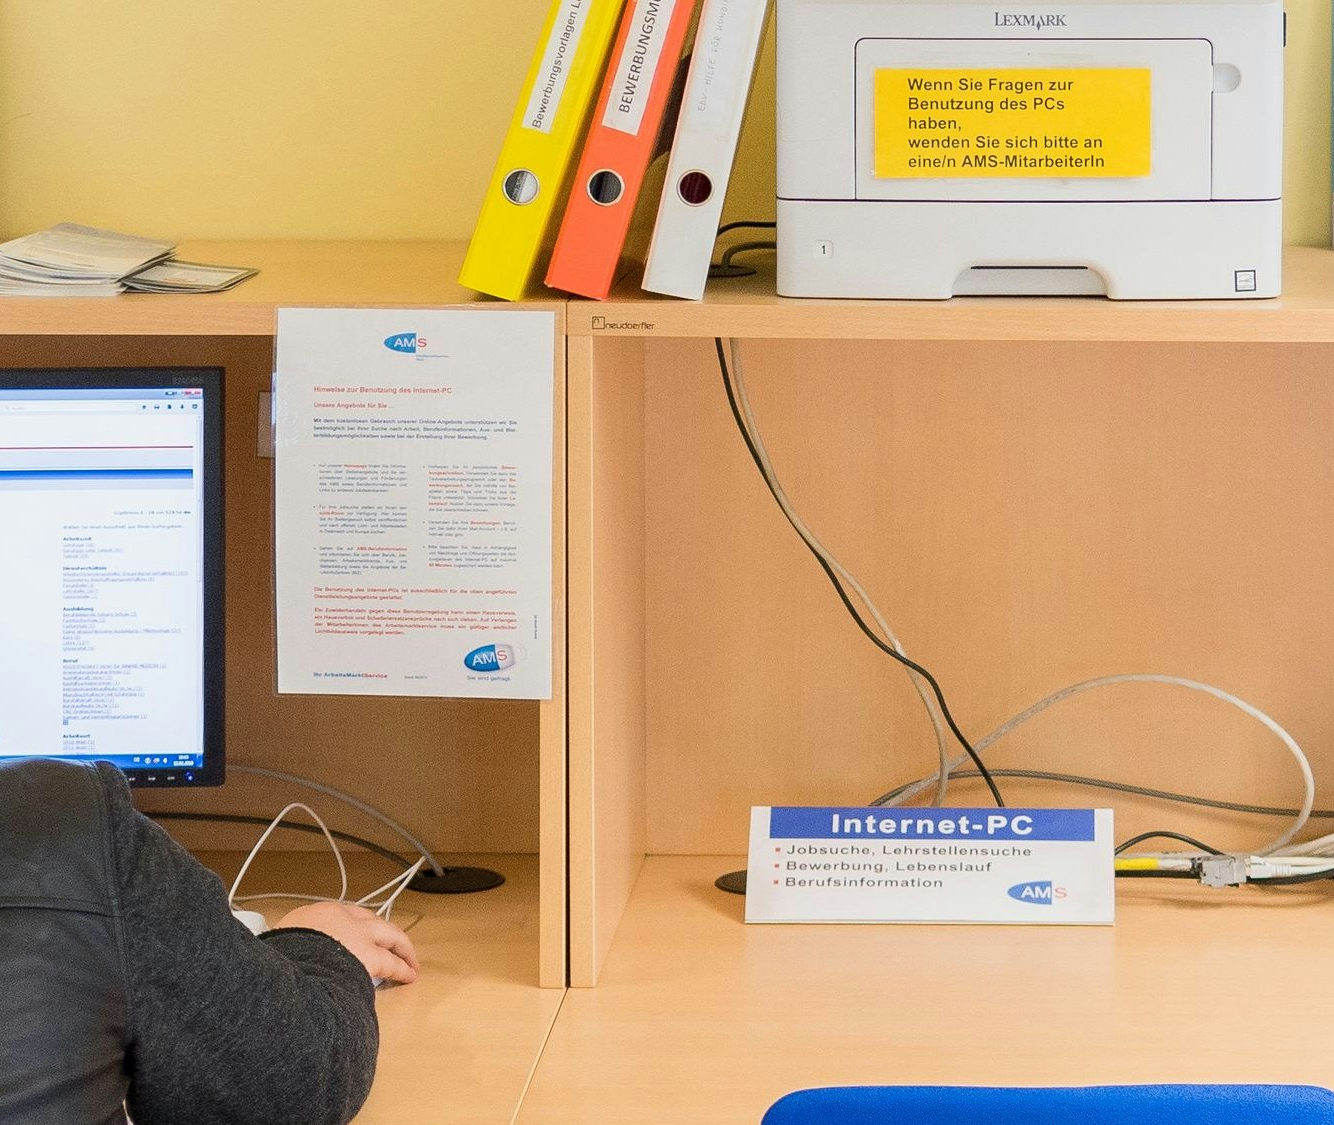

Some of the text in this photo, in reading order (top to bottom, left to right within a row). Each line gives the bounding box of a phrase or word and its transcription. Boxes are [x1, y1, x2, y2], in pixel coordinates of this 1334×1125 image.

[995, 12, 1067, 29] LEXMARK
[532, 11, 578, 128] Bewerbungsvorlagen
[908, 78, 1074, 93] Wenn Sie Fragen zur
[908, 97, 1065, 113] Benutzung des PCs
[908, 117, 962, 131] haben,
[908, 135, 1103, 149] wenden Sie sich bitte an
[908, 155, 956, 168] eine/n
[820, 244, 826, 255] 1
[393, 337, 427, 349] AMS
[472, 650, 507, 666] AMS
[831, 813, 1034, 836] Internet-PC
[786, 844, 1032, 858] Jobsuche, Lehrstellensuche
[786, 860, 993, 874] Bewerbung, Lebenslauf
[785, 876, 943, 888] Berufsinformation
[1021, 885, 1067, 899] AMS
